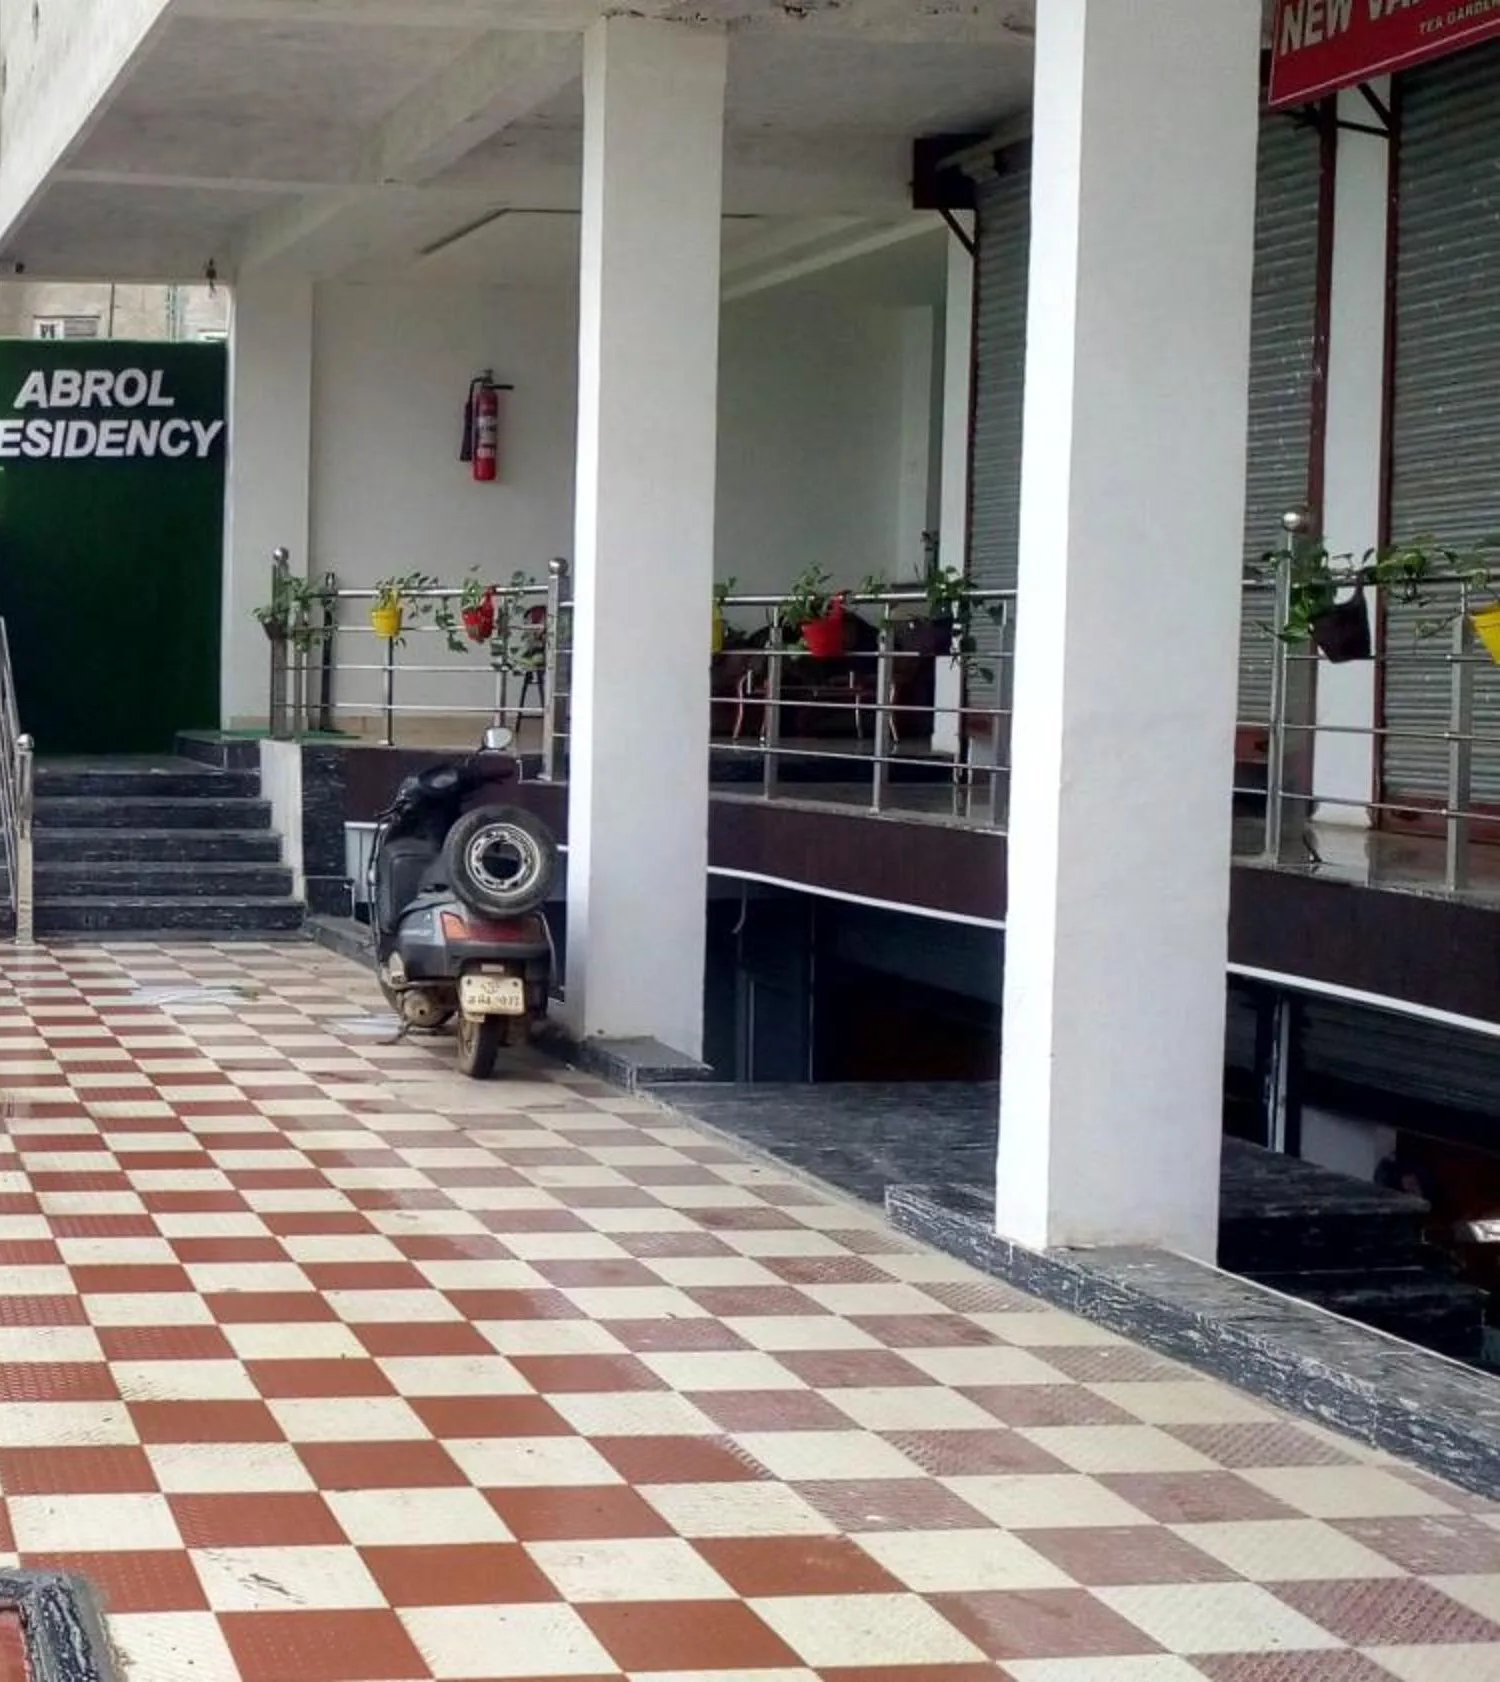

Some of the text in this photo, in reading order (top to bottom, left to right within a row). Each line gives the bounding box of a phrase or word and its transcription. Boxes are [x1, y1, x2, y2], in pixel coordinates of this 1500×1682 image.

[1280, 0, 1352, 56] NEW
[1419, 16, 1443, 35] TEA
[13, 368, 175, 408] ABROL
